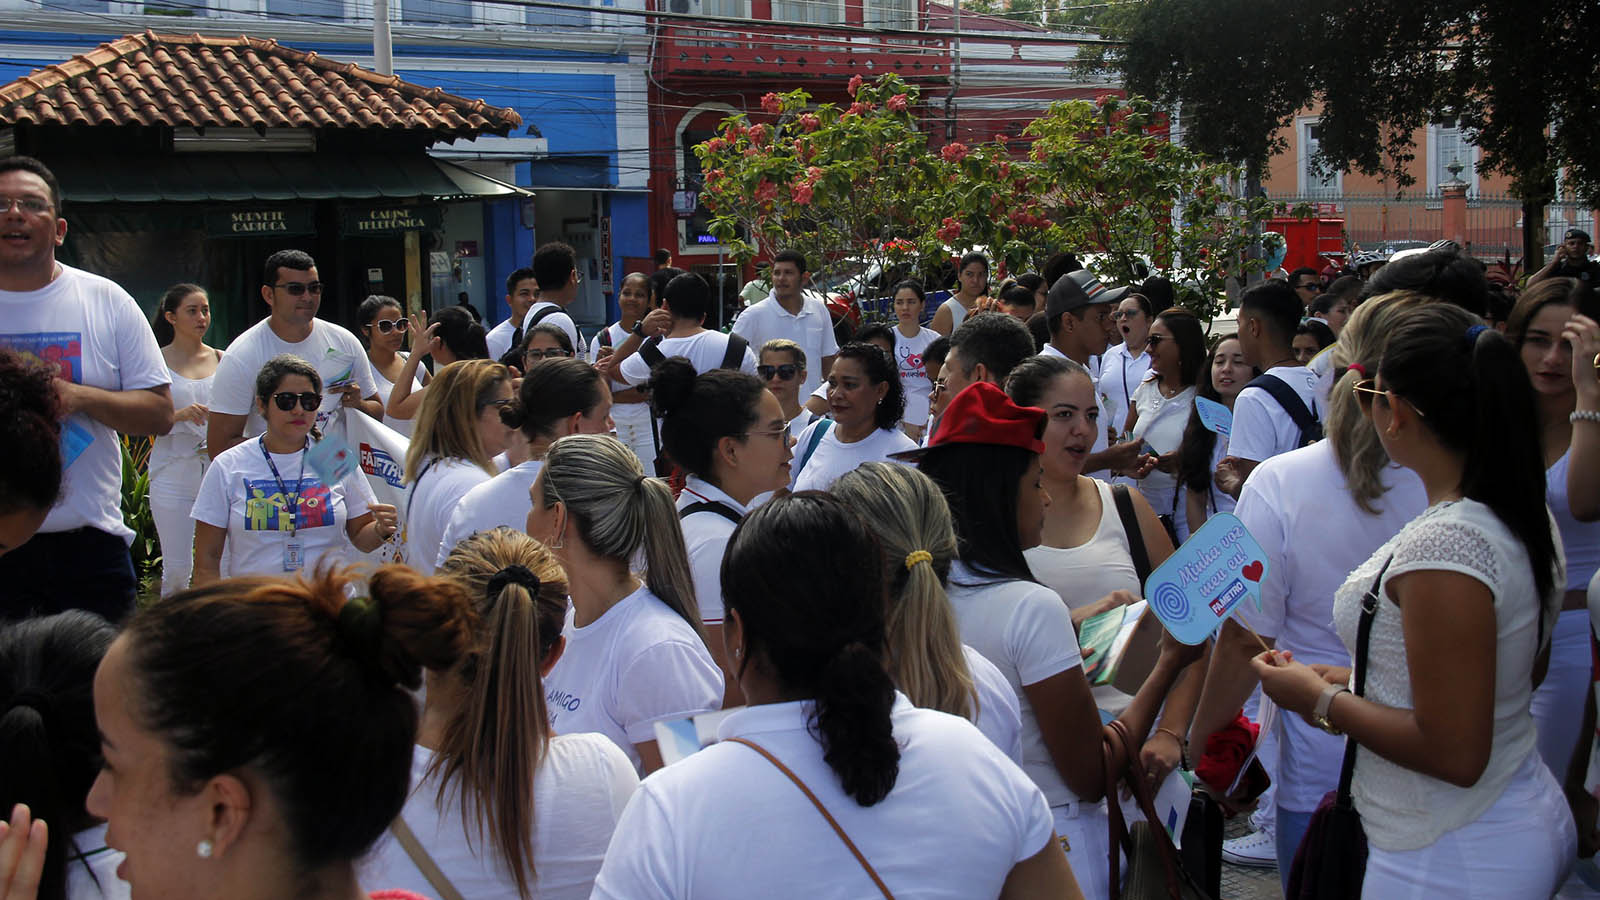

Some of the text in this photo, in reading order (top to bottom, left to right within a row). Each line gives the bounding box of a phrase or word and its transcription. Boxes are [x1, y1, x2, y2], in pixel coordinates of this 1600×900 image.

[231, 211, 285, 221] SORVETE
[370, 209, 408, 219] CABINE
[231, 221, 287, 232] CARIOCA
[1178, 525, 1246, 589] Minha voz
[1199, 543, 1249, 598] meu eu!
[1211, 581, 1244, 614] FAMETRO
[547, 688, 581, 712] AMIGO
